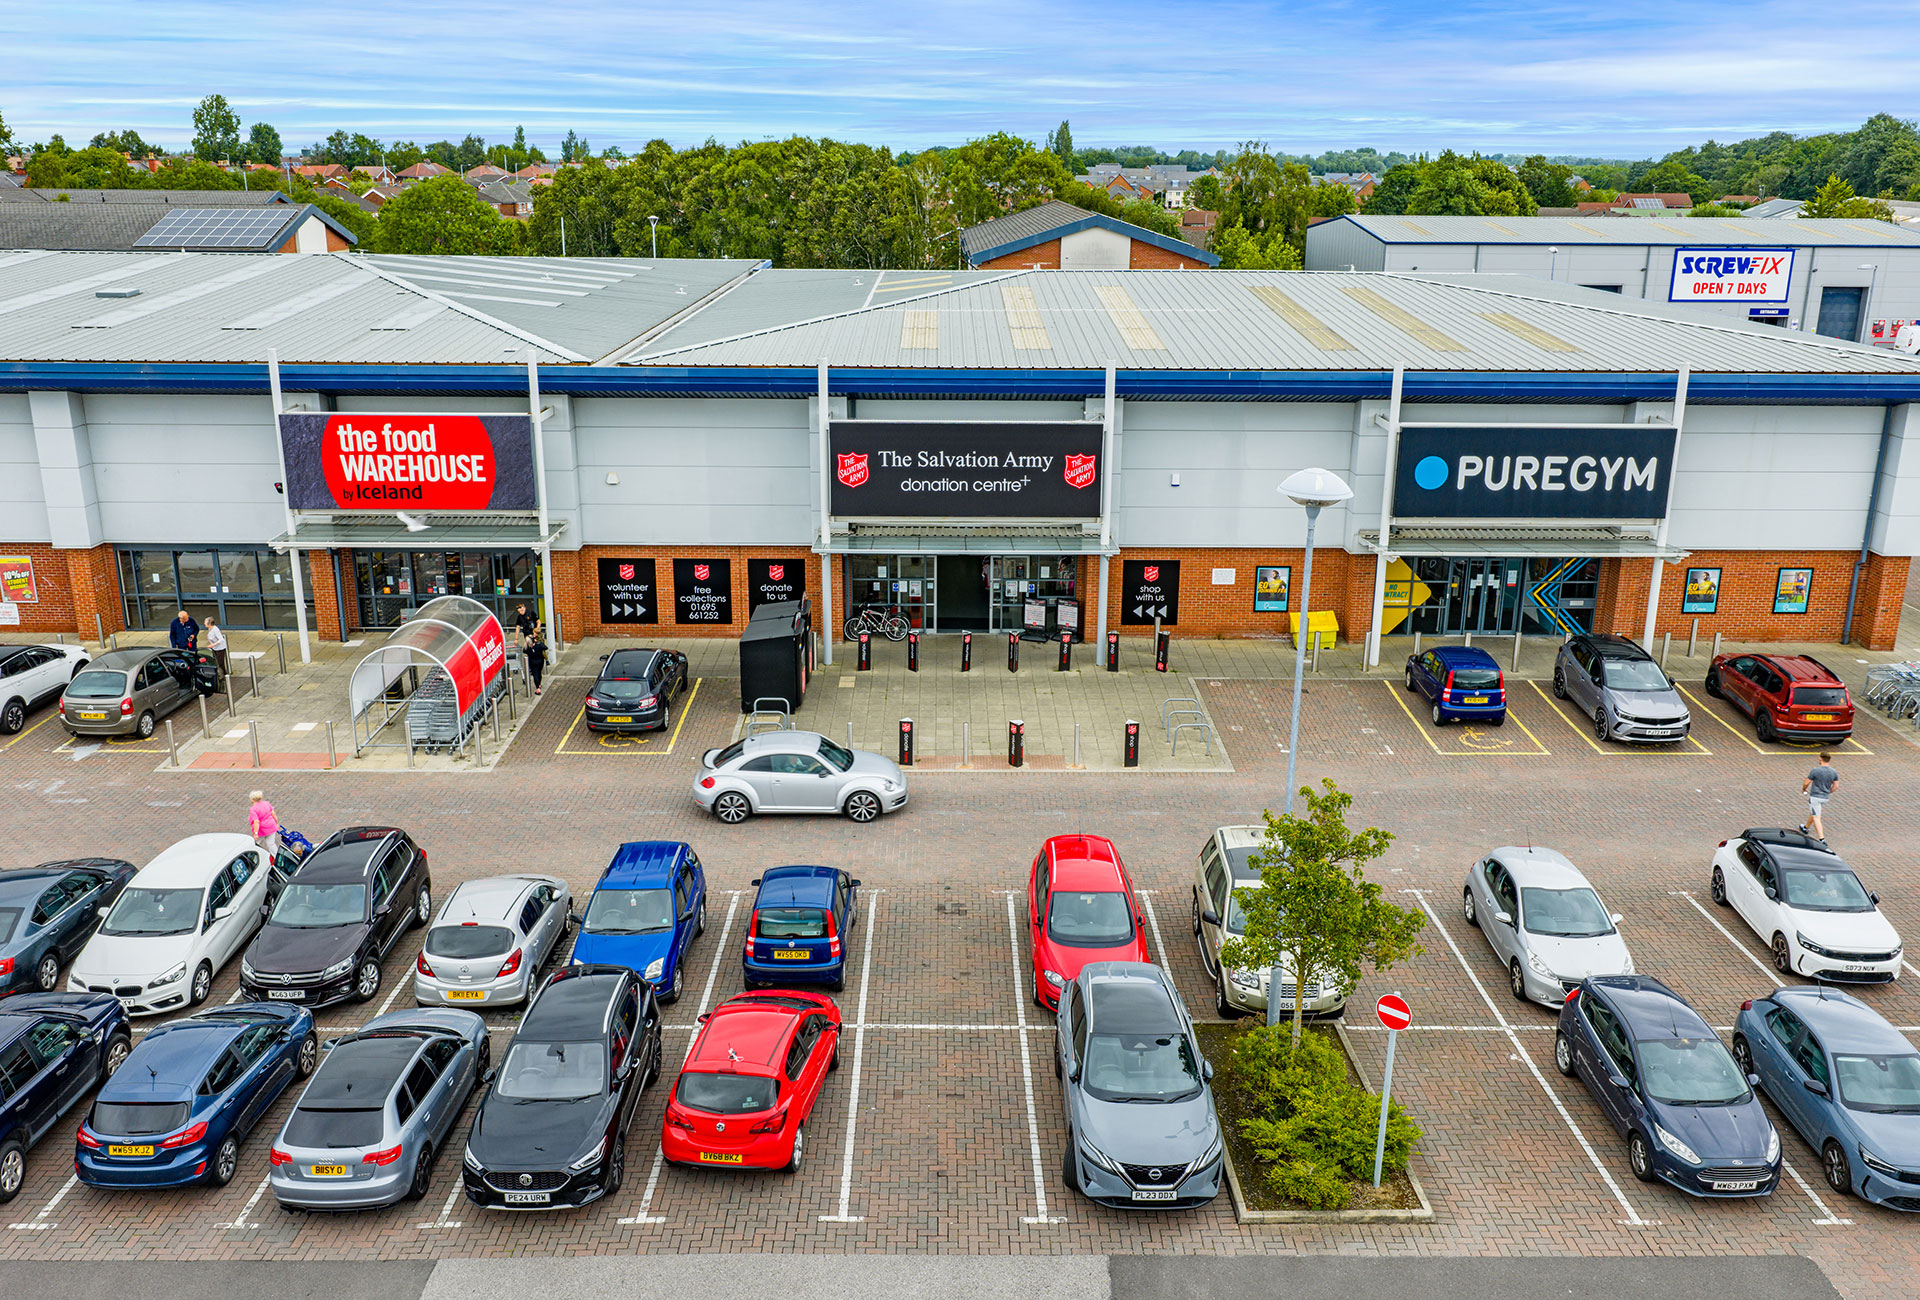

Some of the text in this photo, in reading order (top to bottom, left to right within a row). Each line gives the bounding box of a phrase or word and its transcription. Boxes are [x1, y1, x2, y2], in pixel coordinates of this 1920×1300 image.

[1682, 256, 1785, 279] SCREWFIX
[1693, 282, 1767, 295] OPEN 7 DAYS
[336, 423, 436, 453] the food
[844, 456, 855, 467] THE
[878, 451, 1054, 472] The Salvation Army
[1071, 458, 1082, 468] THE
[339, 454, 487, 483] WAREHOUSE
[840, 459, 867, 479] SALVATION
[1066, 460, 1094, 480] SALVATION
[1457, 455, 1657, 491] PUREGYM
[849, 469, 865, 483] ARMY
[1076, 471, 1092, 484] ARMY
[900, 477, 969, 492] donation
[342, 484, 423, 502] by Iceland
[607, 584, 649, 592] volunteer
[694, 586, 712, 594] free
[760, 584, 793, 592] donate
[1139, 585, 1162, 595] shop
[613, 591, 632, 600] with
[680, 594, 727, 603] collections
[766, 591, 775, 600] to
[1136, 593, 1165, 602] with us
[690, 603, 716, 611] 01695
[689, 611, 719, 620] 661252
[112, 1146, 151, 1154] MW69 KJZ
[724, 1154, 740, 1162] BKZ
[508, 1194, 529, 1202] PE24
